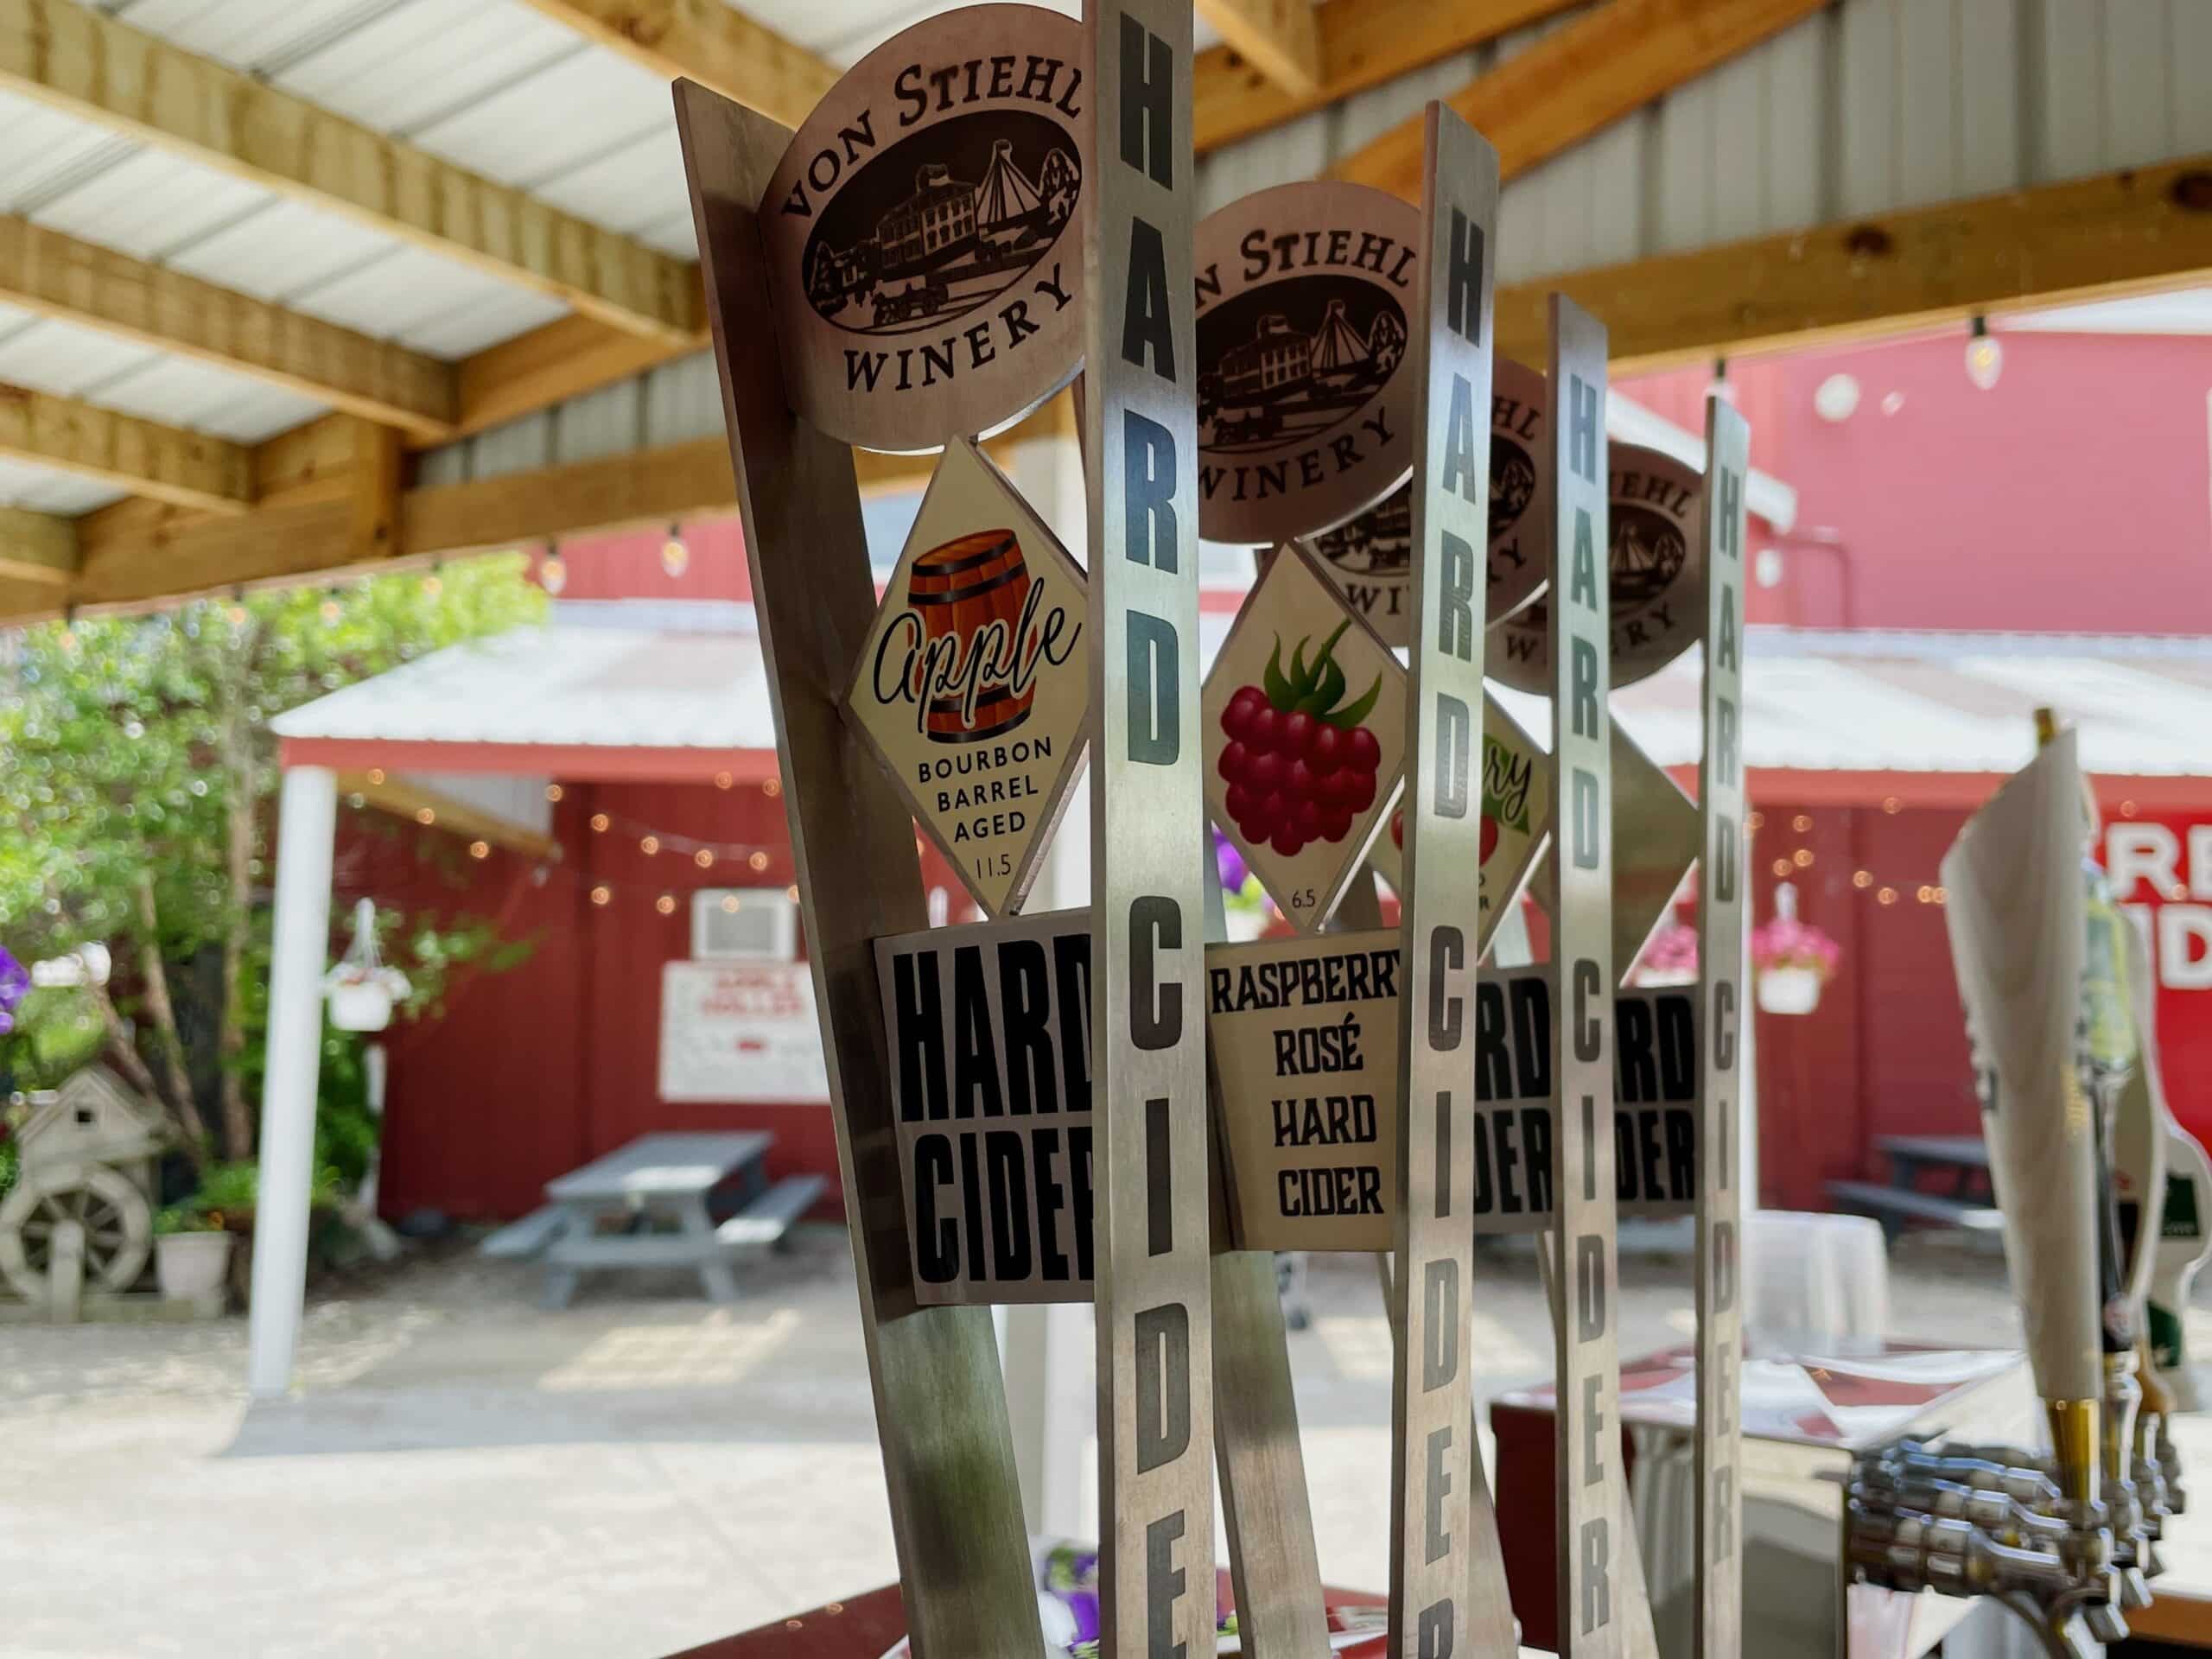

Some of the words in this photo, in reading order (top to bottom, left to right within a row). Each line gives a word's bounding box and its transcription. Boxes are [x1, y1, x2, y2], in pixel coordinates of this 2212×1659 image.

[781, 110, 878, 221] VON
[843, 263, 1072, 393] WINERY
[1119, 11, 1179, 766] HARD
[1433, 207, 1485, 819] HARD
[1569, 372, 1599, 871] HARD
[1715, 465, 1739, 903] HARD
[918, 736, 1052, 783] BOURBON
[937, 774, 1039, 813] BARREL
[953, 810, 1027, 843] AGED
[976, 853, 1012, 880] 11.5
[1291, 889, 1316, 909] 6.5
[893, 933, 1093, 1122] HARD
[1209, 949, 1401, 1014] RASPBERR
[1272, 1011, 1363, 1077] ROSÉ
[1271, 1094, 1377, 1147] HARD
[1277, 1165, 1385, 1217] CIDER
[1128, 895, 1191, 1659] CIDE
[1573, 958, 1611, 1637] CIDER
[1713, 981, 1734, 1567] CIDER
